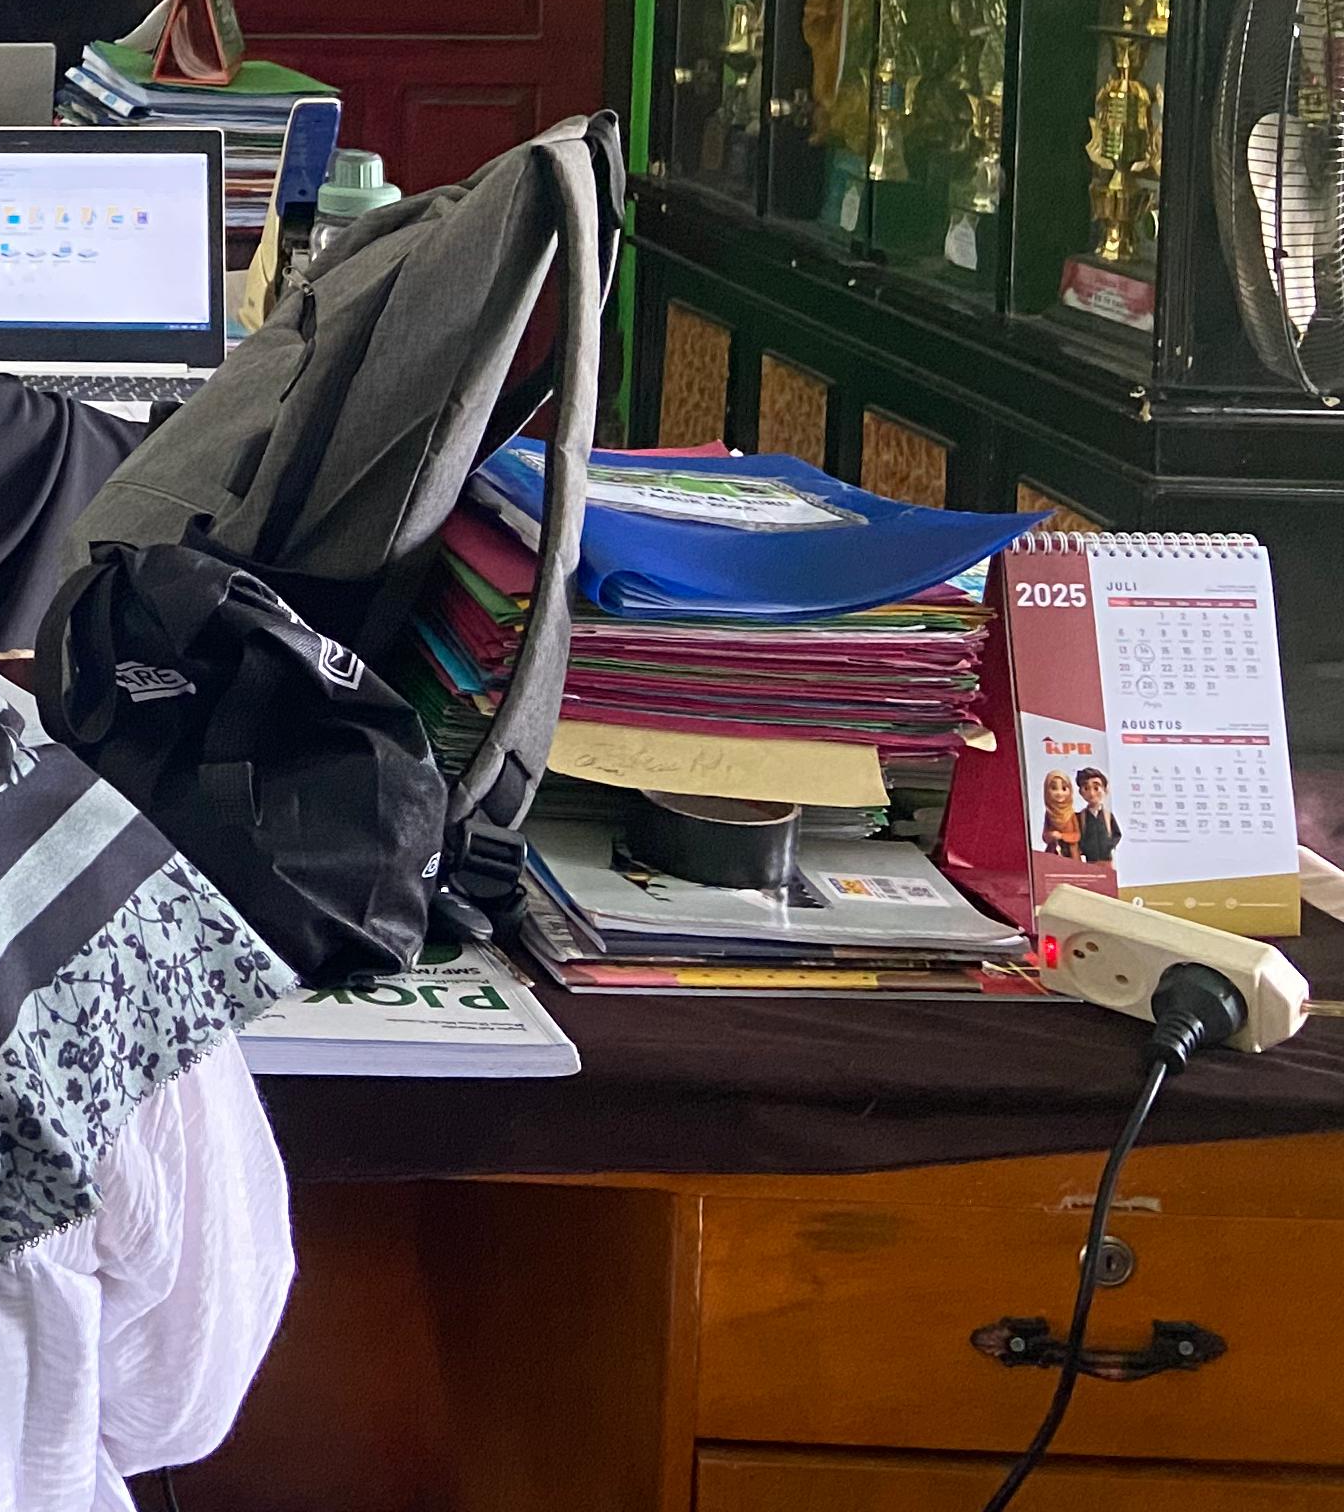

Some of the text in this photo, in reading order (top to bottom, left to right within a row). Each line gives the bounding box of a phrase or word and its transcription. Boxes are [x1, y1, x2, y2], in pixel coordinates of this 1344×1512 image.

[1106, 582, 1138, 592] JULI
[1016, 583, 1087, 608] 2025
[1121, 720, 1182, 730] AGUSTUS
[303, 986, 510, 1009] PJOK
